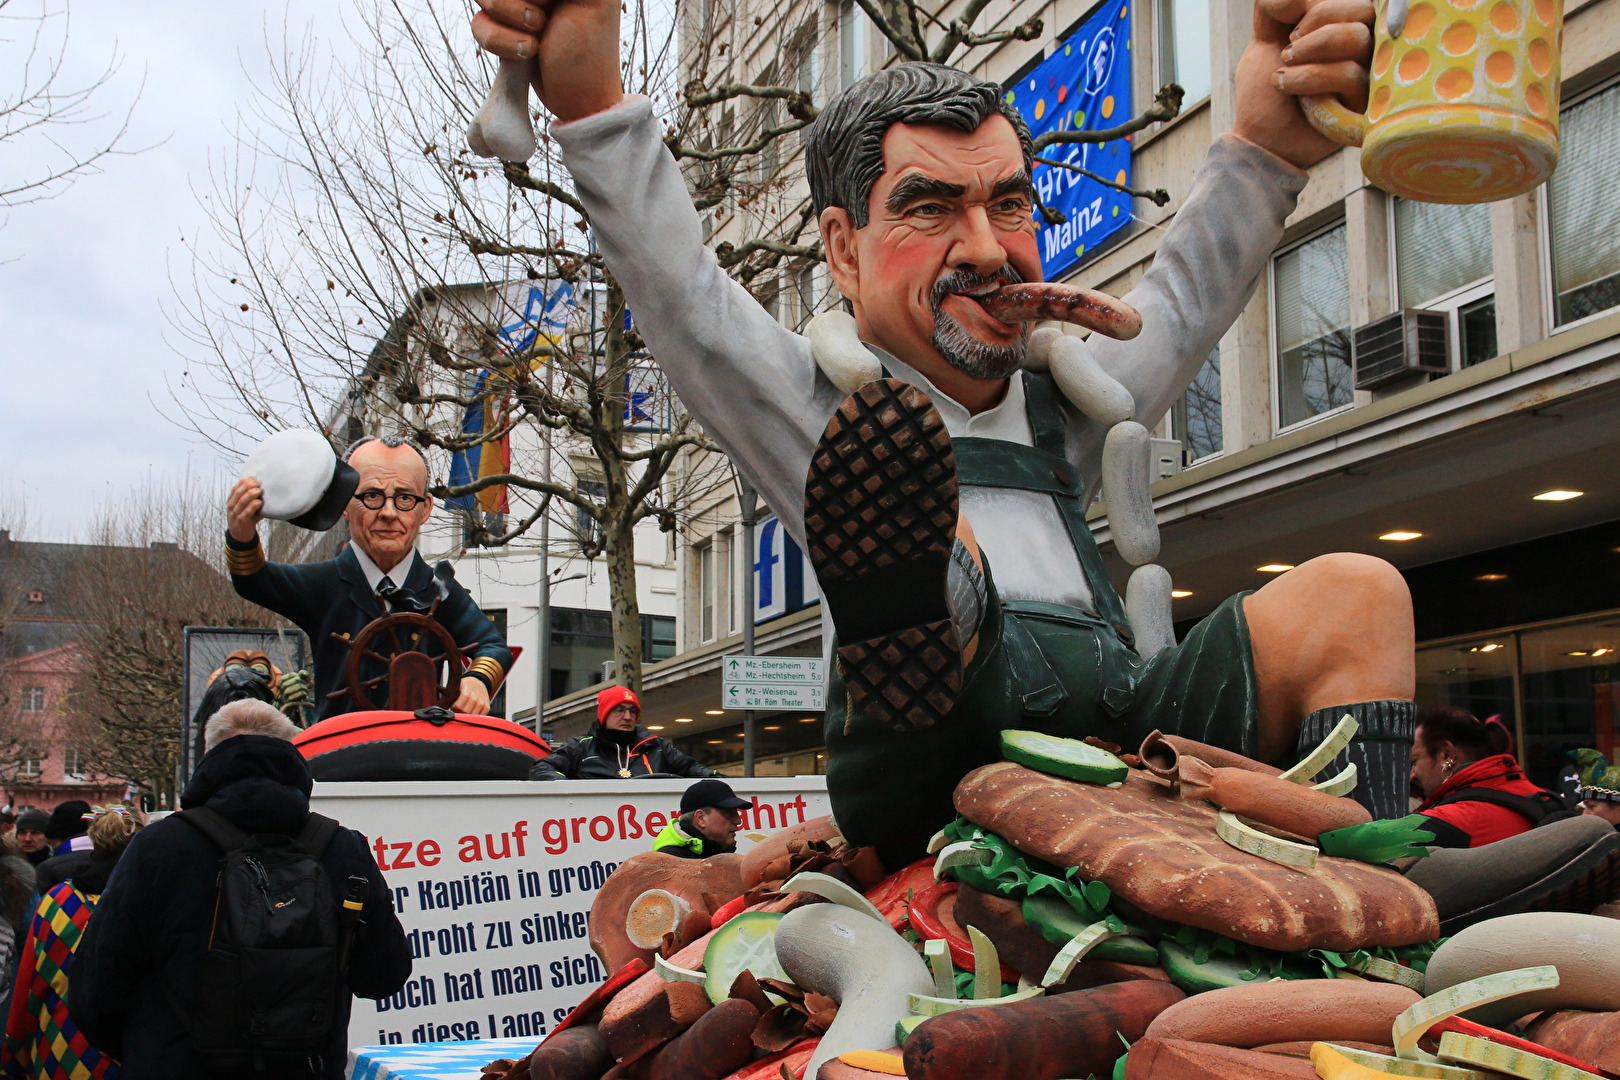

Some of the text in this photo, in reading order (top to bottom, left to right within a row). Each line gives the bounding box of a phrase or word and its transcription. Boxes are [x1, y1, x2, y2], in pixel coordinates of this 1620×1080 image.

[1044, 196, 1103, 263] Mainz
[745, 661, 817, 670] Mz.-Ebersheim 12
[745, 671, 806, 680] Mz.-Hechtsheim
[745, 687, 798, 696] Mz.-Weisenau
[781, 698, 804, 707] Theater
[366, 836, 442, 871] tze
[458, 820, 528, 863] auf
[737, 794, 807, 831] ahrt
[418, 871, 511, 911] Kapitän
[517, 869, 542, 899] in
[407, 910, 591, 959] droht zu sinke
[444, 968, 485, 1003] hat
[491, 963, 543, 997] man
[379, 1029, 403, 1045] in
[412, 1020, 480, 1043] diese
